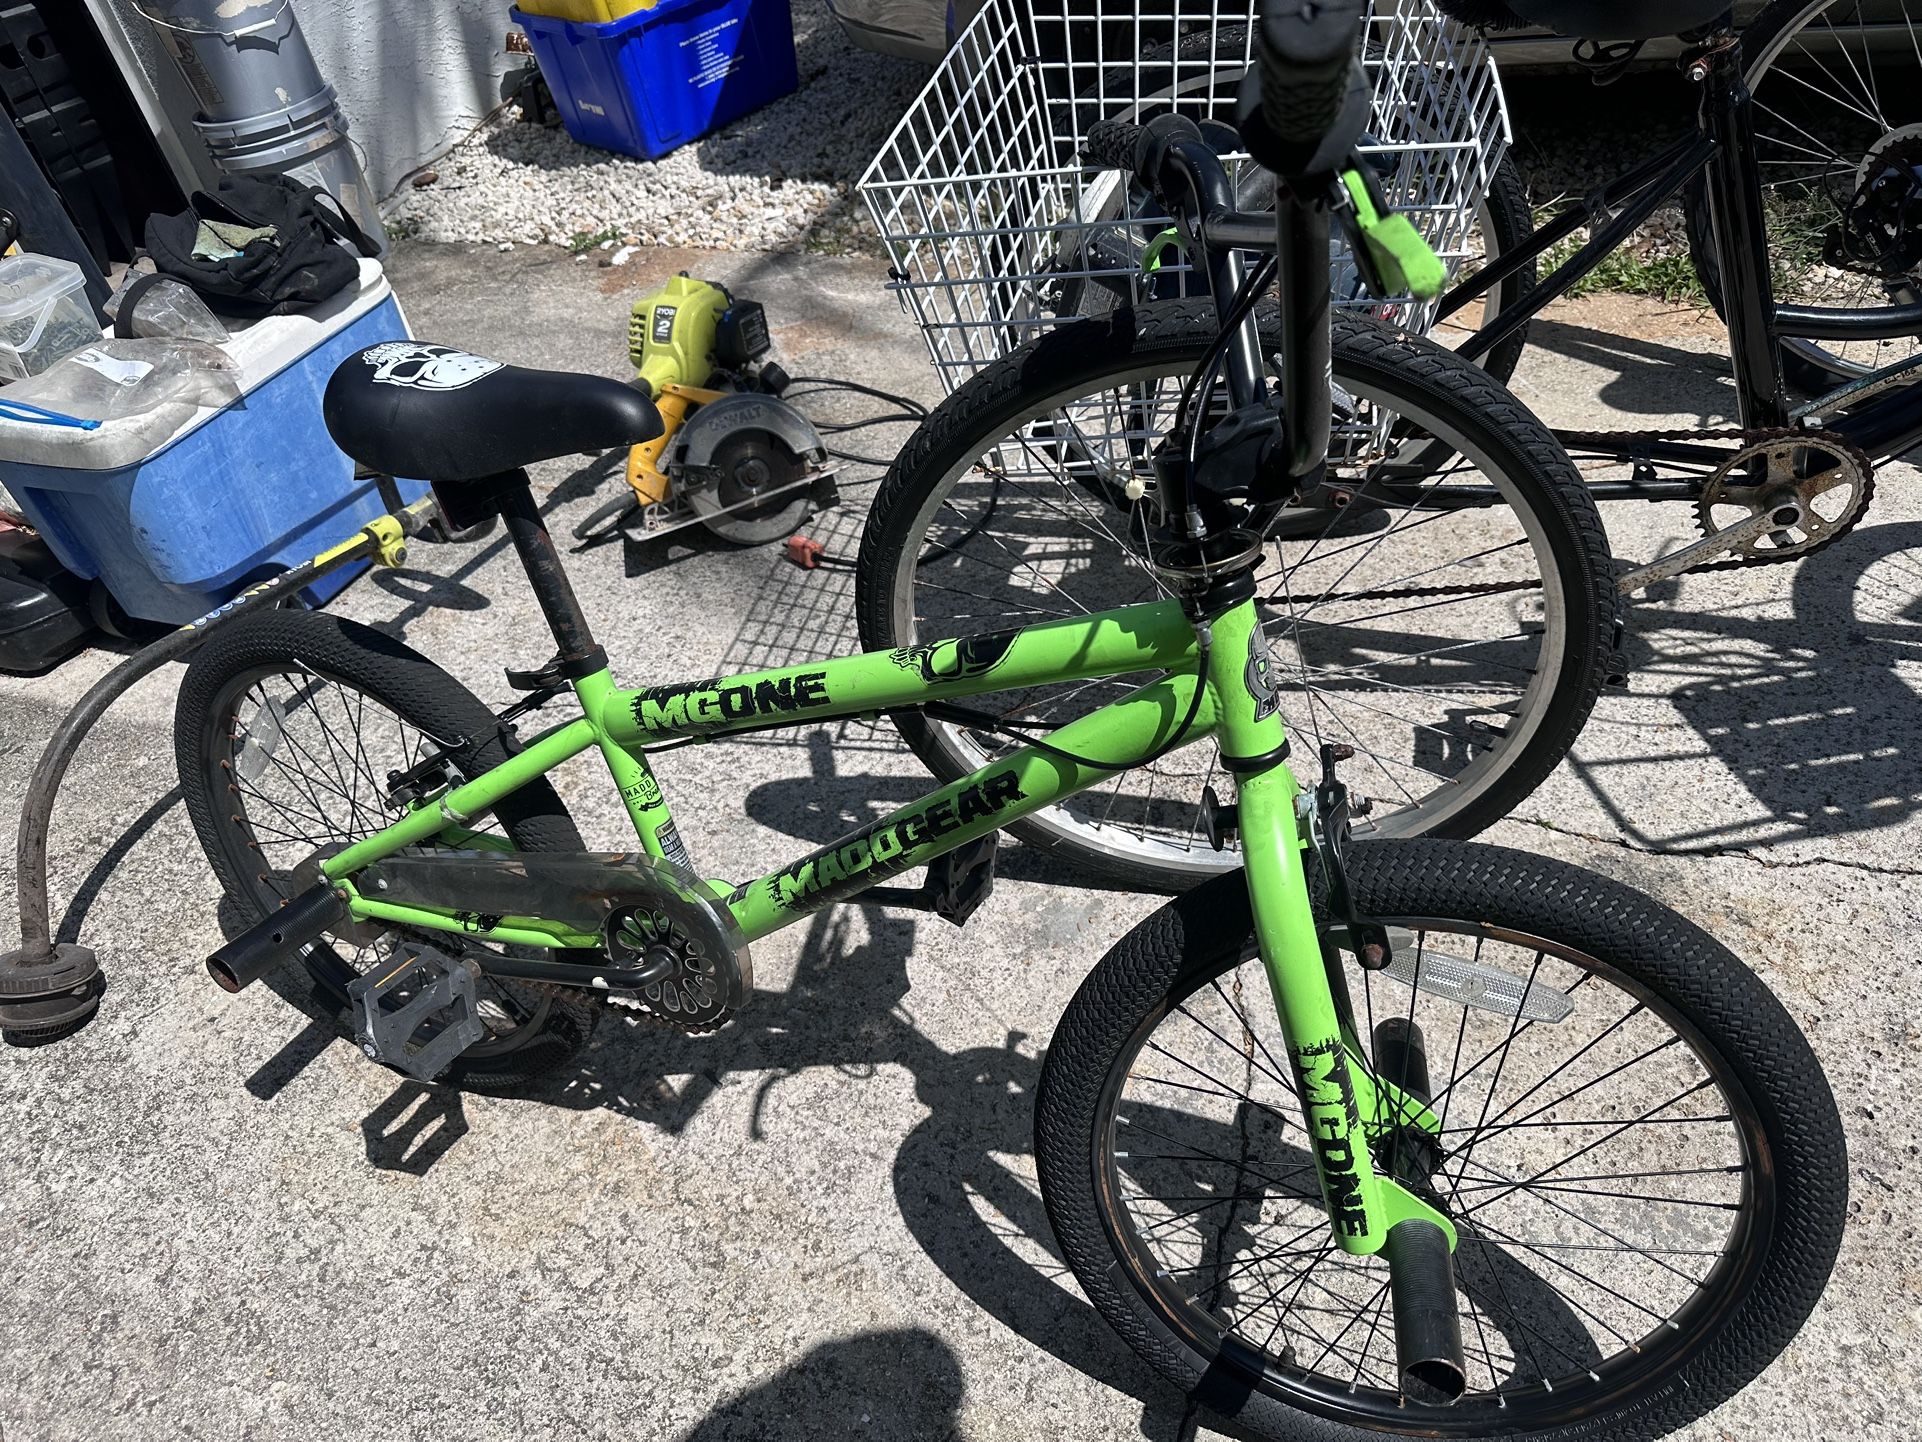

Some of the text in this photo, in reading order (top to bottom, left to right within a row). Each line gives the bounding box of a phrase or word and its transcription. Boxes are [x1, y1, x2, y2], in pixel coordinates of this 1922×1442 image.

[656, 307, 676, 316] RYOBI
[657, 320, 671, 333] 2
[707, 404, 763, 433] DEWALT
[638, 670, 832, 732] MGONE
[625, 780, 652, 798] MADD
[1297, 1046, 1369, 1238] MGONE
